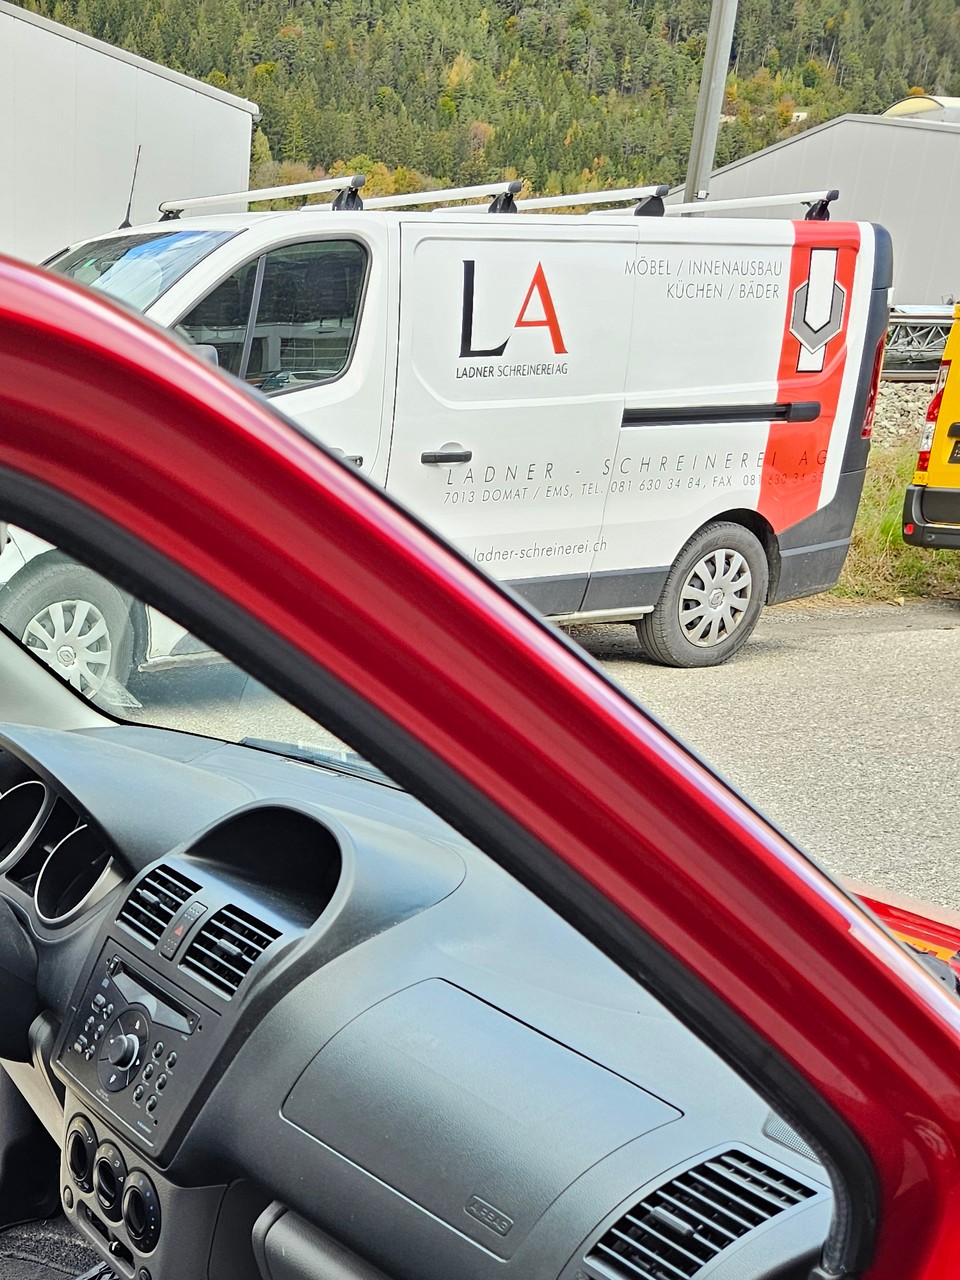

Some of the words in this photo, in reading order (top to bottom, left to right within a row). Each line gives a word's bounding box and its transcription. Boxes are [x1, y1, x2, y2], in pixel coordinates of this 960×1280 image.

[624, 256, 672, 276] MÖBEL
[677, 259, 684, 277] /
[688, 260, 783, 277] INNENAUSBAU
[666, 280, 723, 299] KÜCHEN
[727, 283, 735, 300] /
[739, 280, 780, 299] BÄDER
[458, 259, 568, 358] LA
[456, 366, 494, 379] LADNER
[497, 363, 555, 378] SCHREINEREI
[554, 362, 568, 375] AG
[447, 462, 554, 485] LADNER
[602, 451, 777, 476] SCHREINEREI
[798, 449, 827, 466] AG
[443, 490, 475, 505] 7013
[482, 487, 528, 502] DOMAT
[545, 485, 573, 499] EMS,
[581, 483, 604, 496] TEL.
[610, 480, 632, 493] 081
[639, 479, 661, 491] 630
[667, 478, 681, 490] 34
[687, 477, 706, 490] 84,
[713, 475, 732, 488] FAX
[768, 472, 787, 486] 630
[114, 1160, 120, 1168] 3
